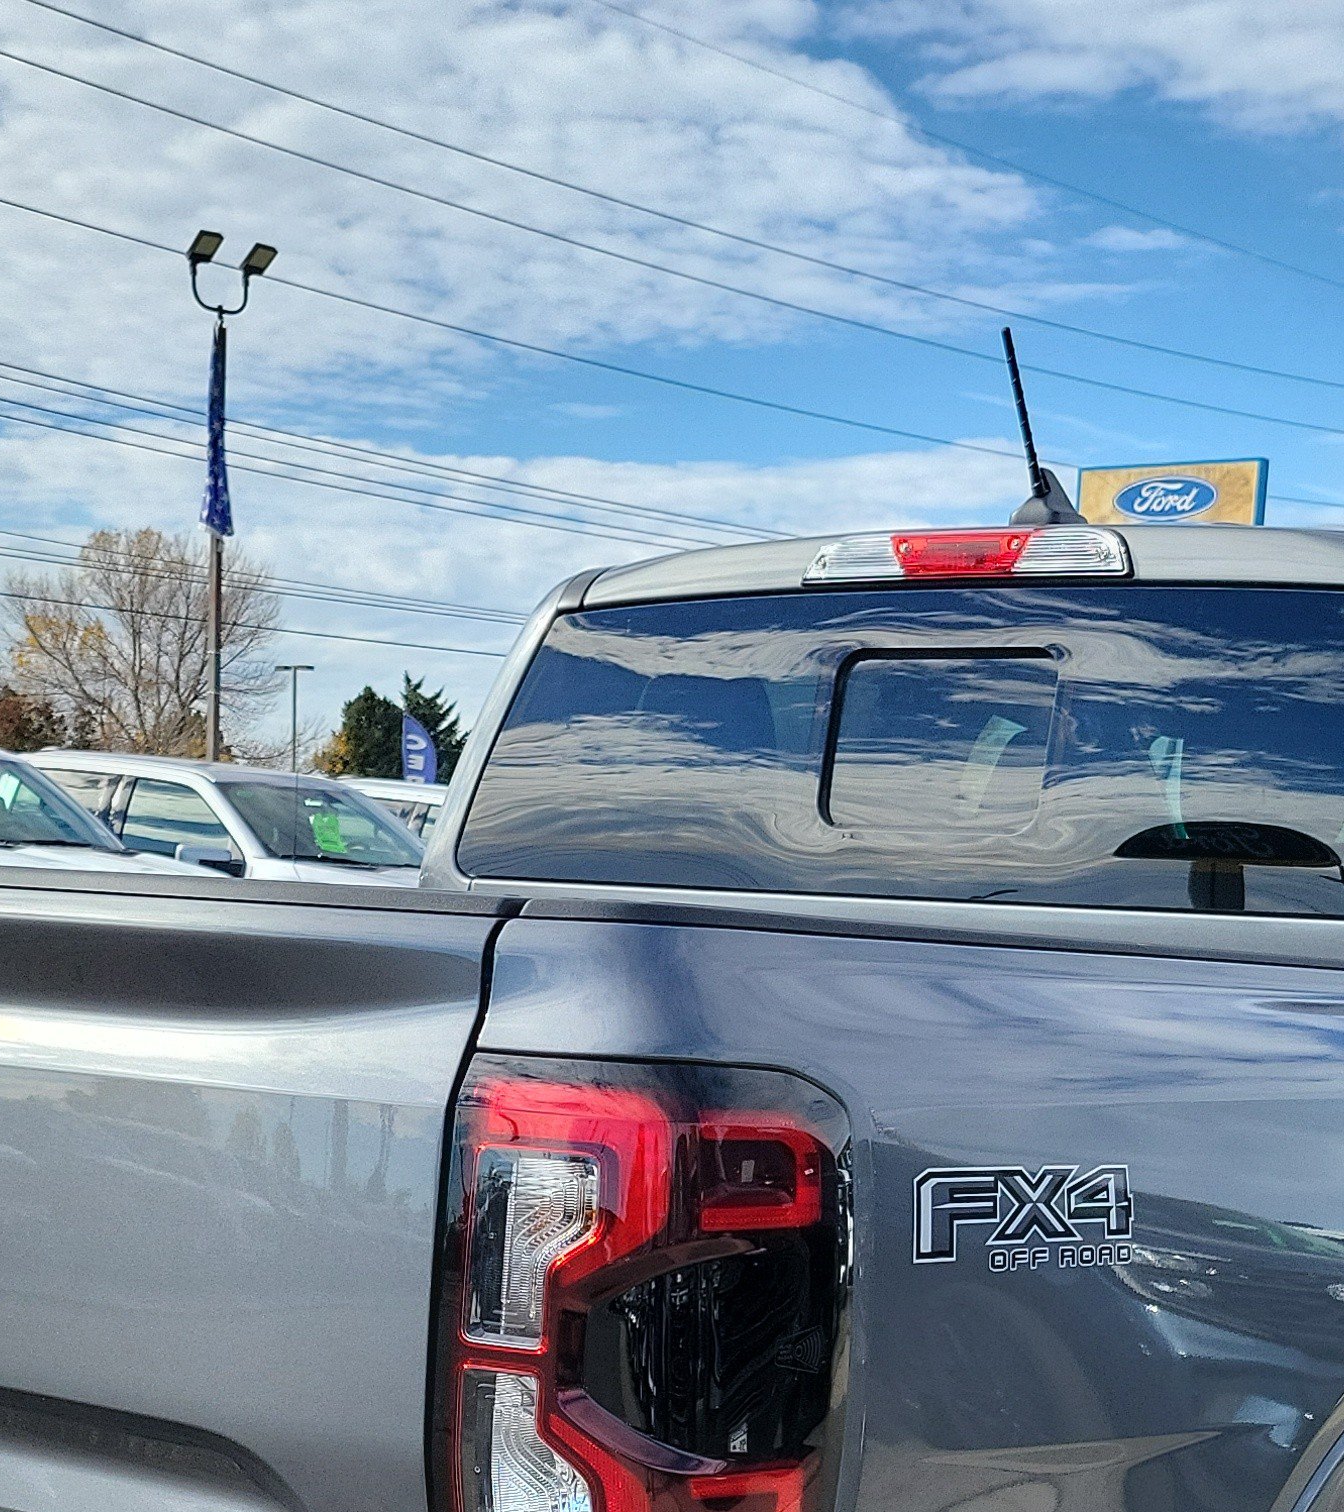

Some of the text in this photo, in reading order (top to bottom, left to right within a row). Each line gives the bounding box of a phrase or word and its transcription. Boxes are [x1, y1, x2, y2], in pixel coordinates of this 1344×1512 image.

[1132, 481, 1200, 513] Ford
[913, 1164, 1134, 1264] FX4
[988, 1243, 1133, 1272] OFF ROAD
